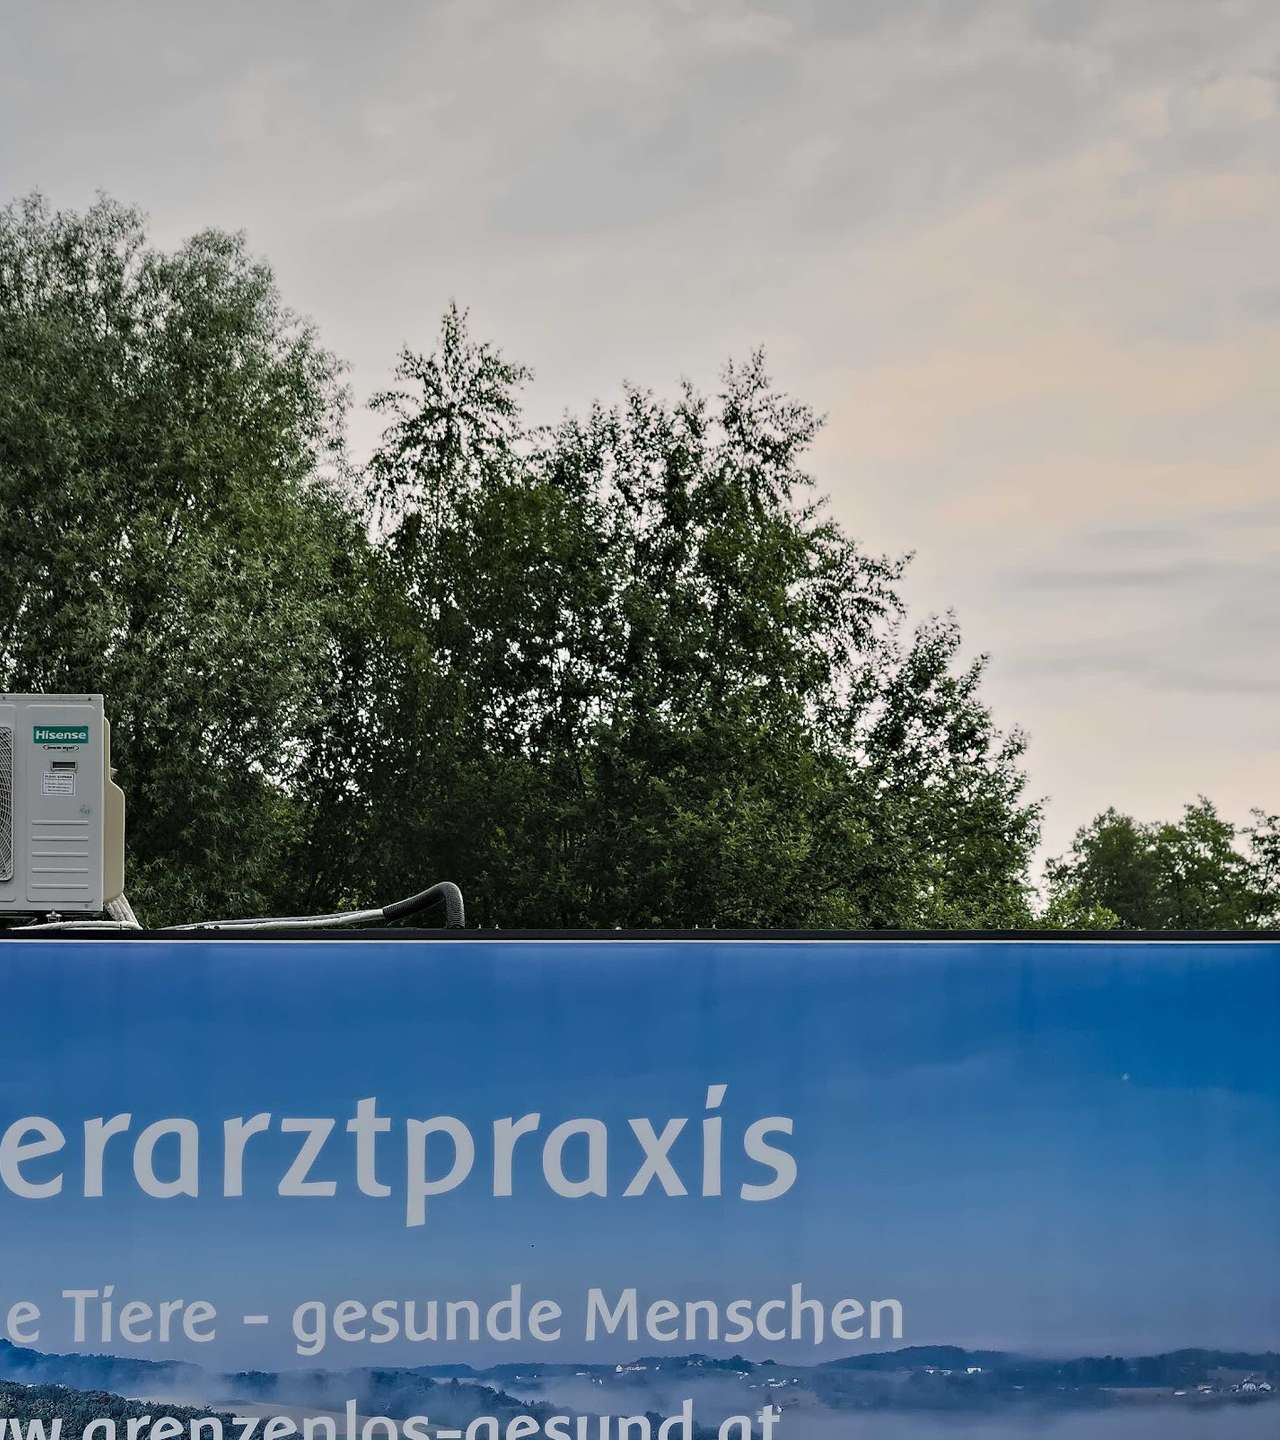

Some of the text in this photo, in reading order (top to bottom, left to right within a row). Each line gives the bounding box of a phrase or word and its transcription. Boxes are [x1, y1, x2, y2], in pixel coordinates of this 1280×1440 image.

[35, 730, 87, 740] Hisense
[61, 1283, 218, 1345] Tiere
[242, 1314, 271, 1325] -
[291, 1282, 564, 1357] gesunde
[584, 1281, 905, 1346] Menschen
